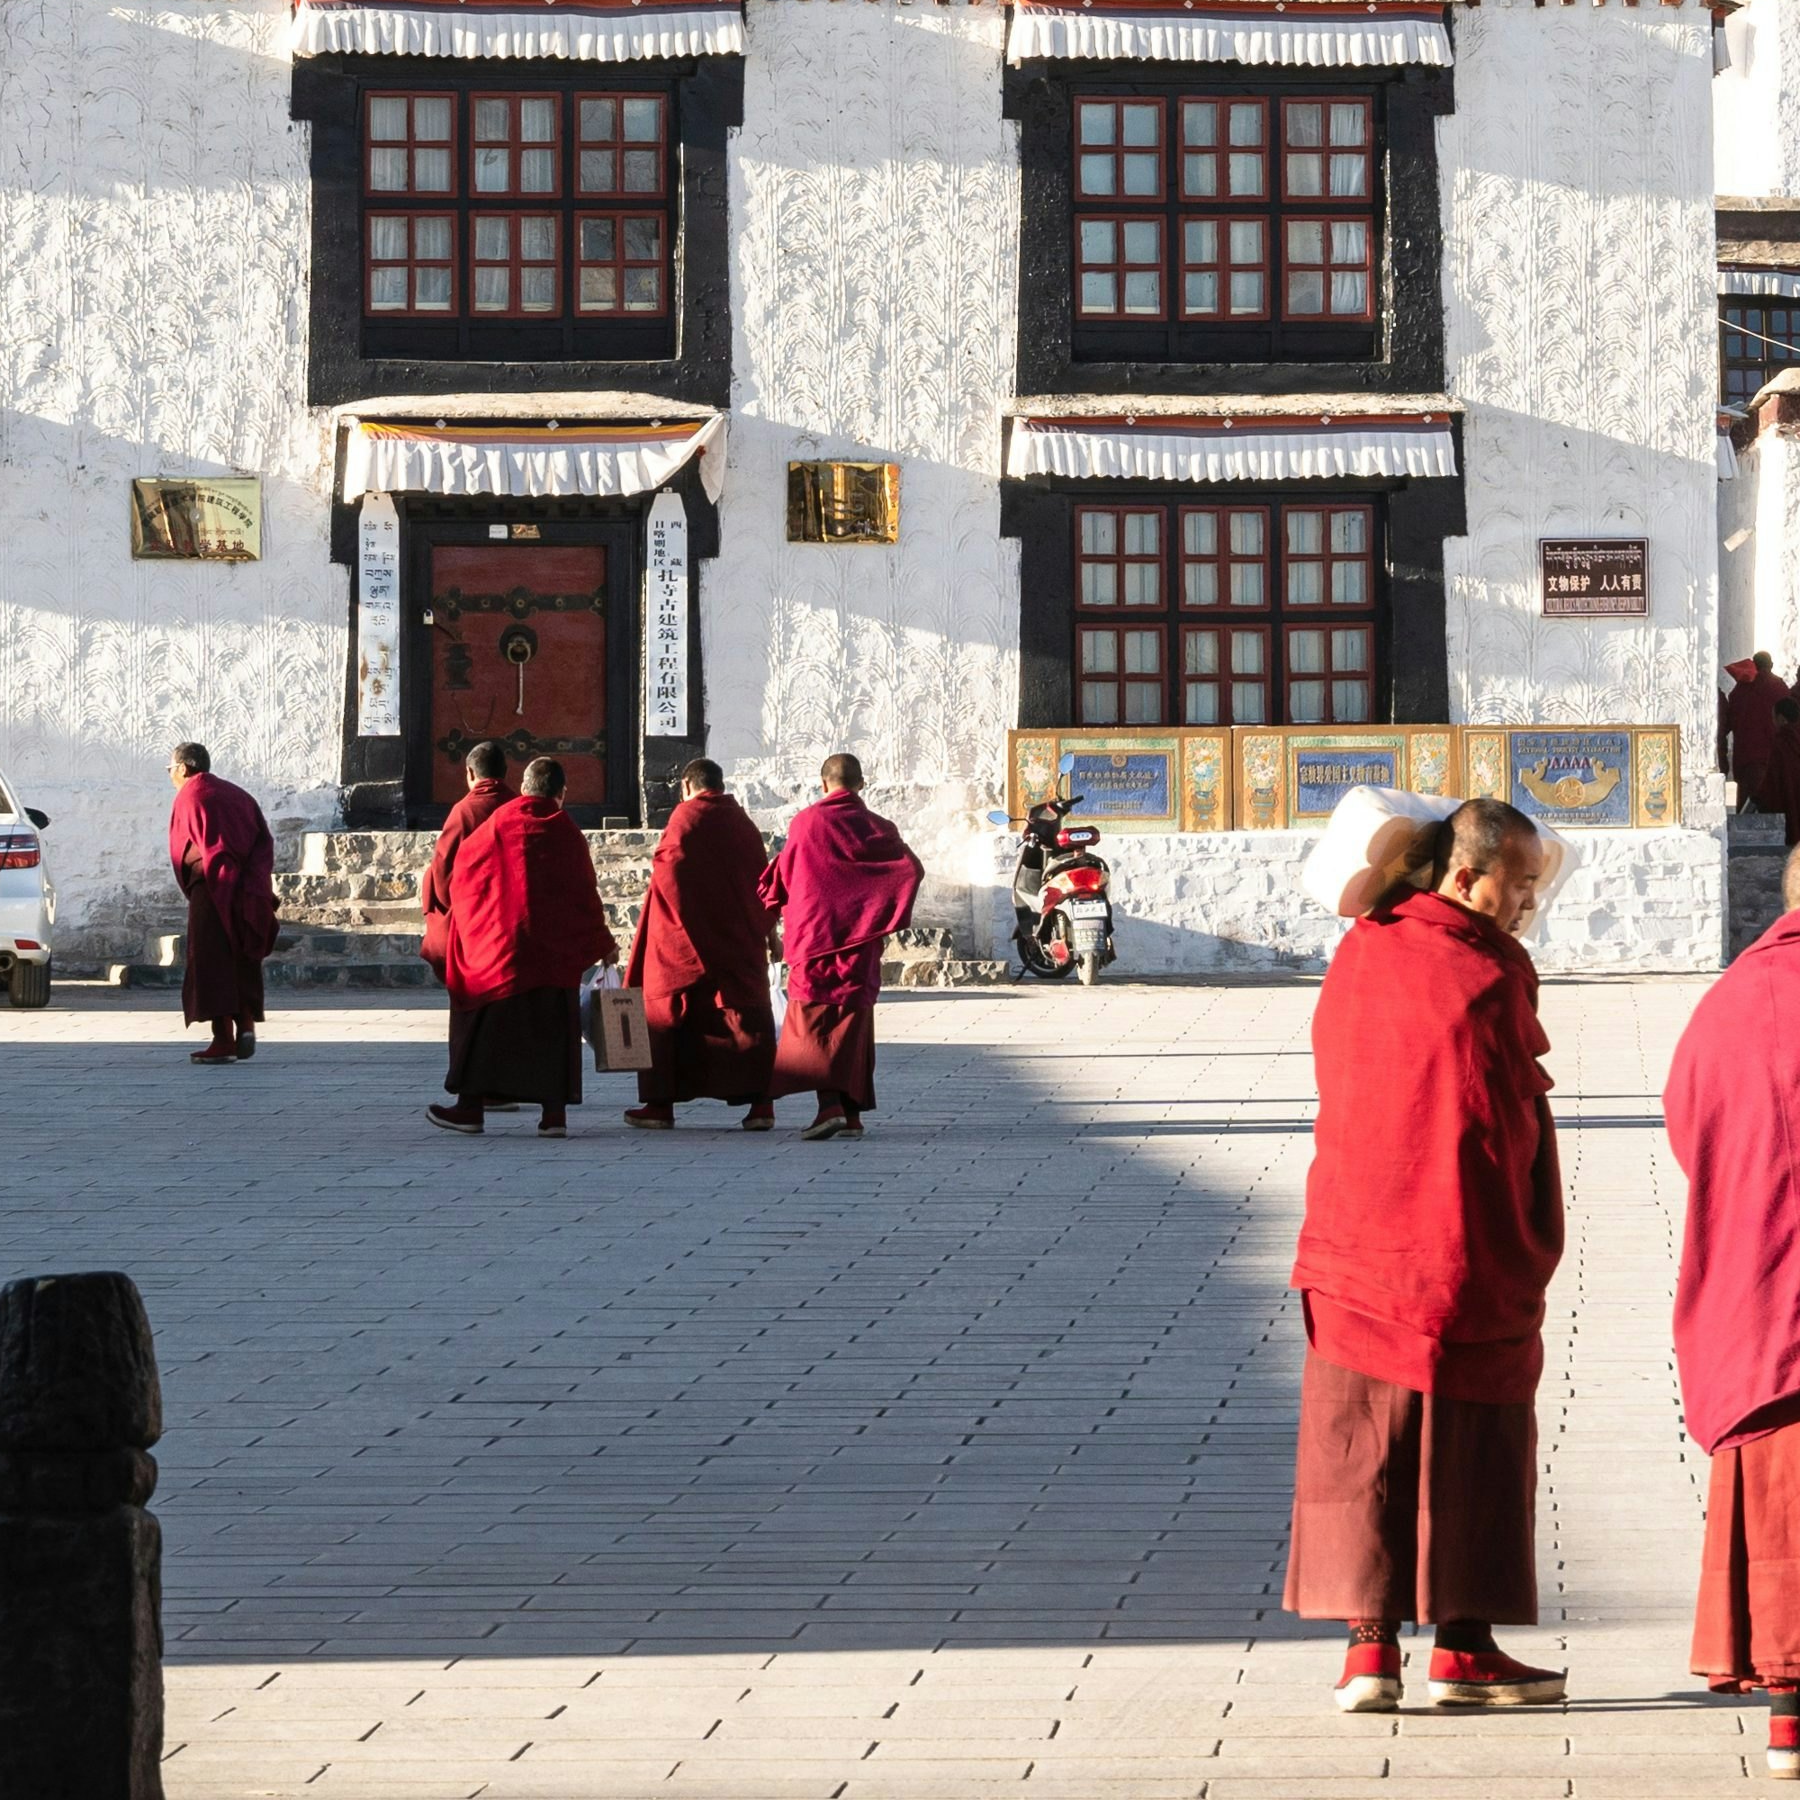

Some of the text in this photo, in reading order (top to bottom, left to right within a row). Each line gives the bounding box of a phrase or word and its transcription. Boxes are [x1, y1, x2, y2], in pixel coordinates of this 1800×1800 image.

[1547, 573, 1642, 592] 文物保护 人人有责
[657, 569, 679, 729] 扎寺古建筑工程有限公司
